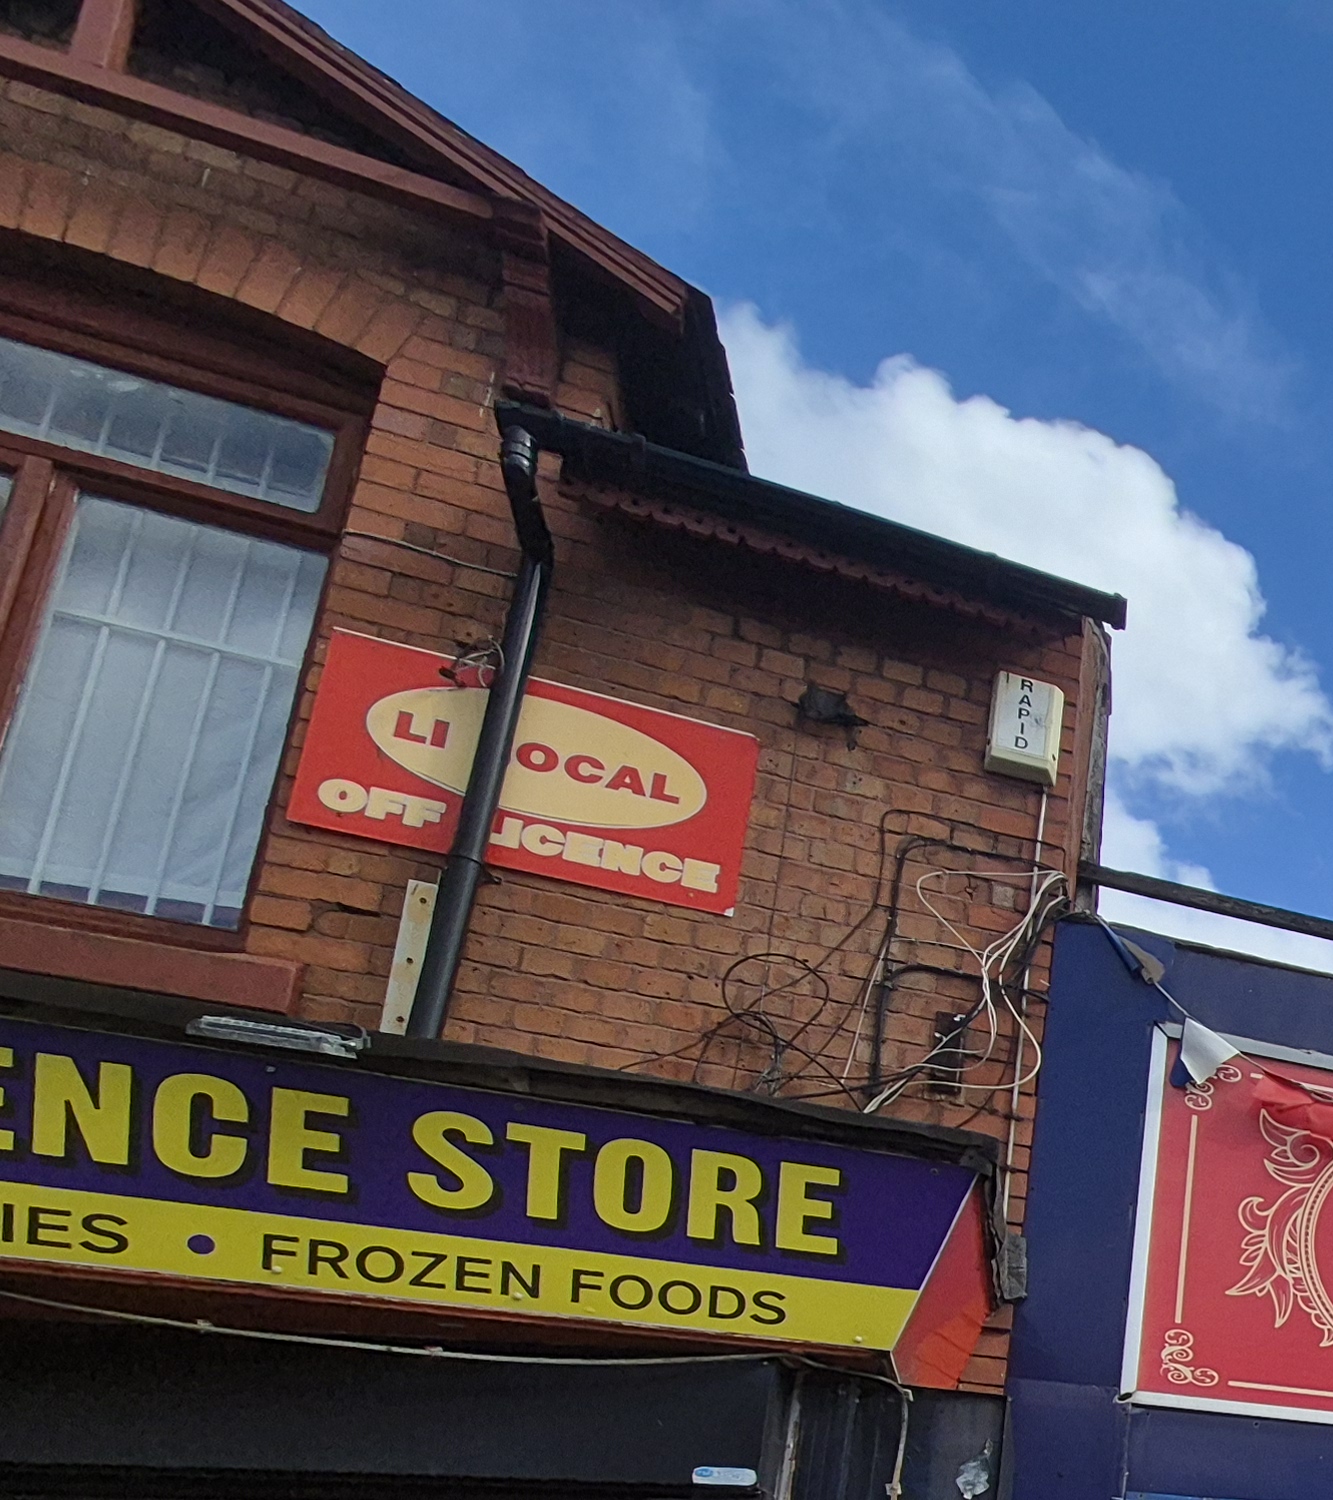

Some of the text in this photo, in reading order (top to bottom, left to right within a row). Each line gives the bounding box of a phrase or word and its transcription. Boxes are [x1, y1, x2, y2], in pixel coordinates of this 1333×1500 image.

[1014, 679, 1034, 749] RAPID
[317, 778, 447, 828] OFF
[516, 741, 680, 804] OCAL
[0, 1047, 842, 1255] NCE STORE
[262, 1234, 790, 1327] FROZEN FOODS
